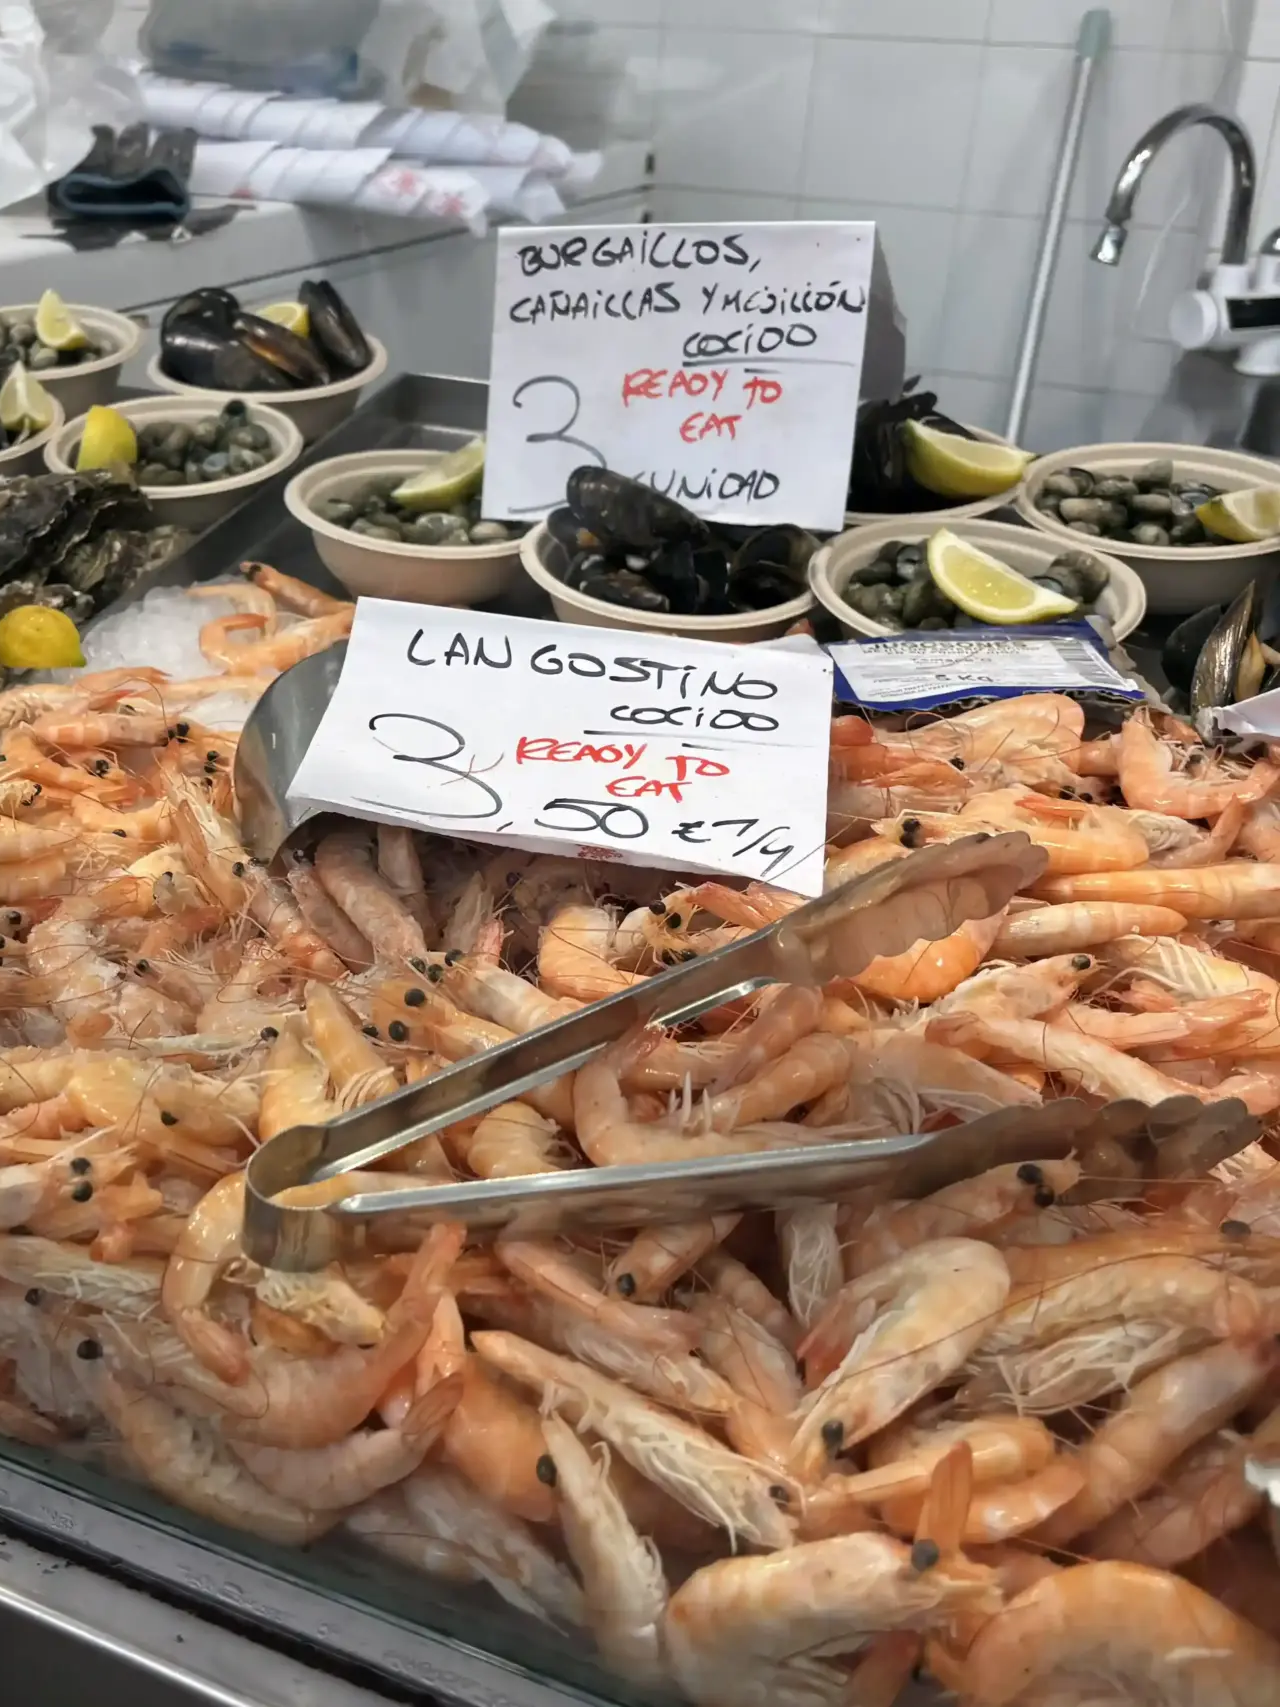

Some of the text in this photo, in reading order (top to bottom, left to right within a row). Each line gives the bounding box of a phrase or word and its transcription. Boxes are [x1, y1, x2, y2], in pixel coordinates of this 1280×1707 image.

[682, 323, 818, 359] COCIDO
[621, 367, 782, 410] READY TO
[679, 412, 741, 443] EAT
[610, 704, 780, 733] COCIDO
[515, 736, 730, 782] READY TO
[605, 777, 692, 803] EAT
